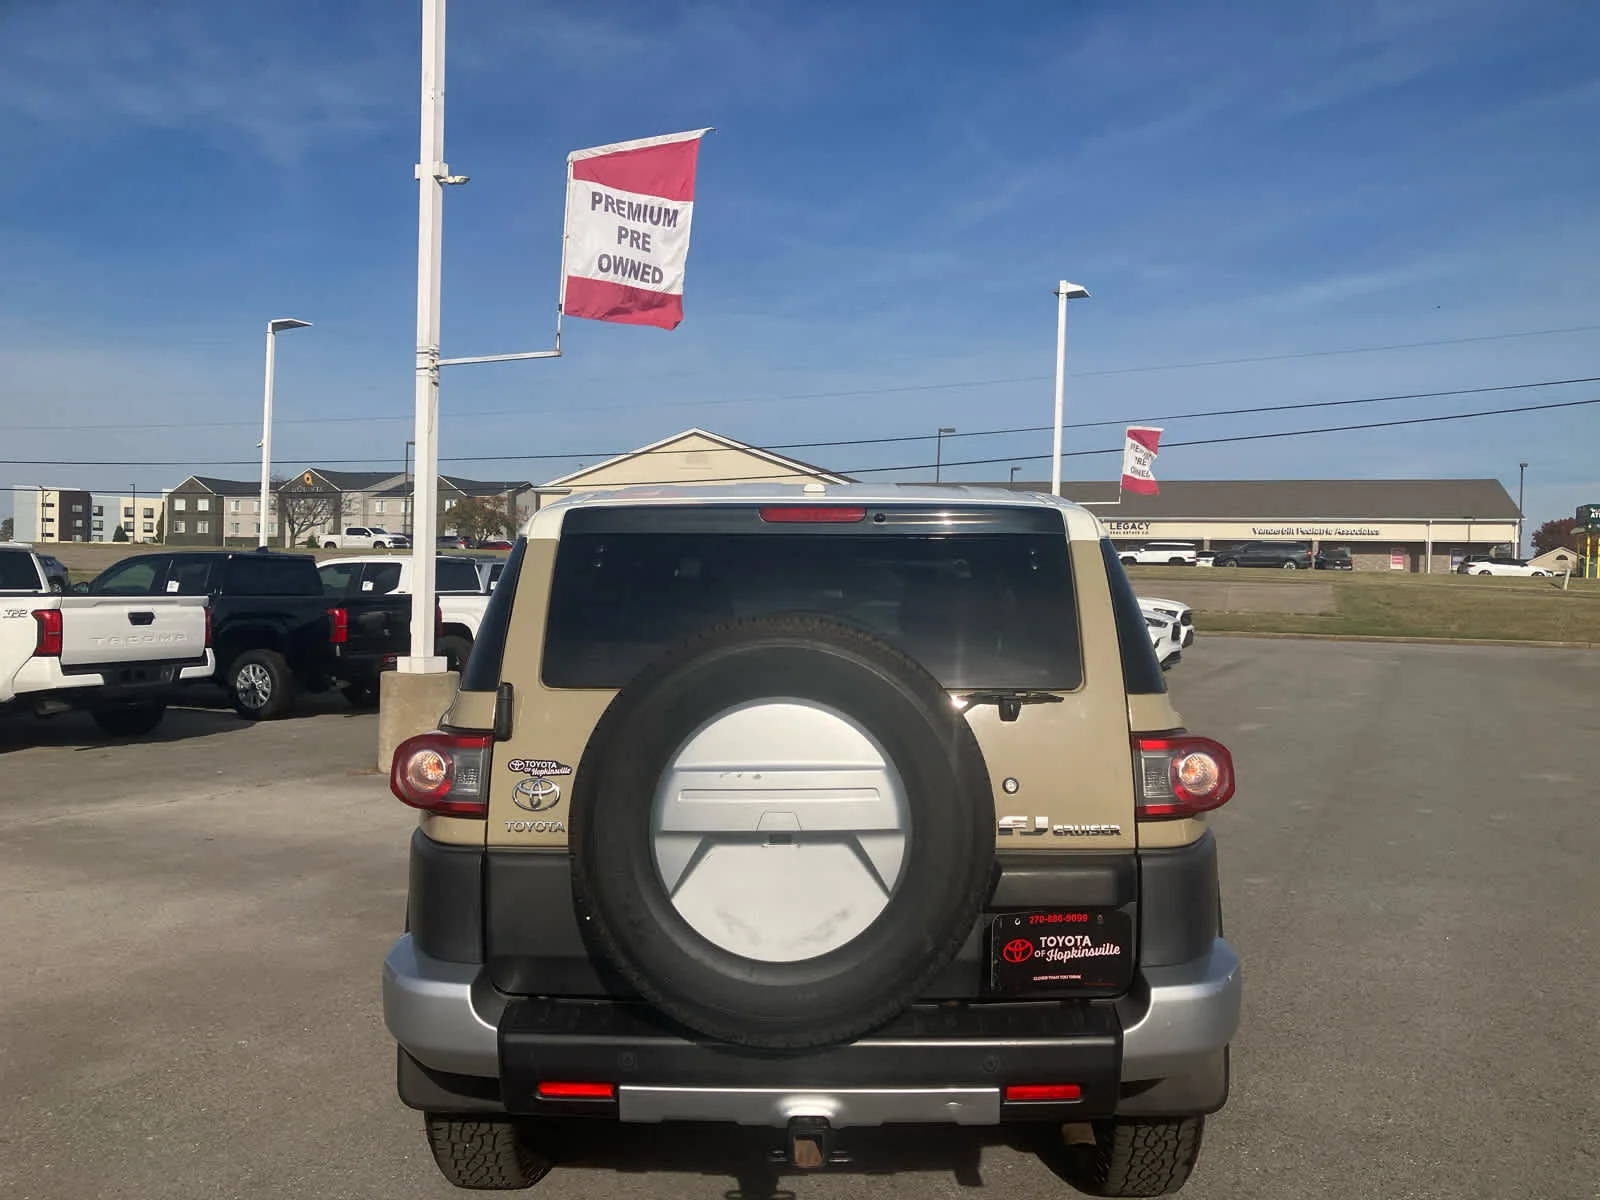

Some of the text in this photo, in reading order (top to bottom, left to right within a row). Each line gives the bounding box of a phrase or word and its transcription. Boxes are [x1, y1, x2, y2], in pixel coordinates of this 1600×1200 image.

[591, 191, 679, 228] PREMIUM
[617, 225, 651, 253] PRE
[598, 253, 664, 285] OWNED
[1110, 521, 1150, 530] LEGACY
[88, 632, 188, 648] TACOMA
[524, 760, 557, 768] TOYOTA
[531, 767, 571, 776] Hopkinsville
[505, 821, 565, 832] TOYOTA
[998, 816, 1121, 837] FJ CRUISER
[1040, 936, 1091, 948] TOYOTA
[1045, 943, 1121, 963] Hopkinsville
